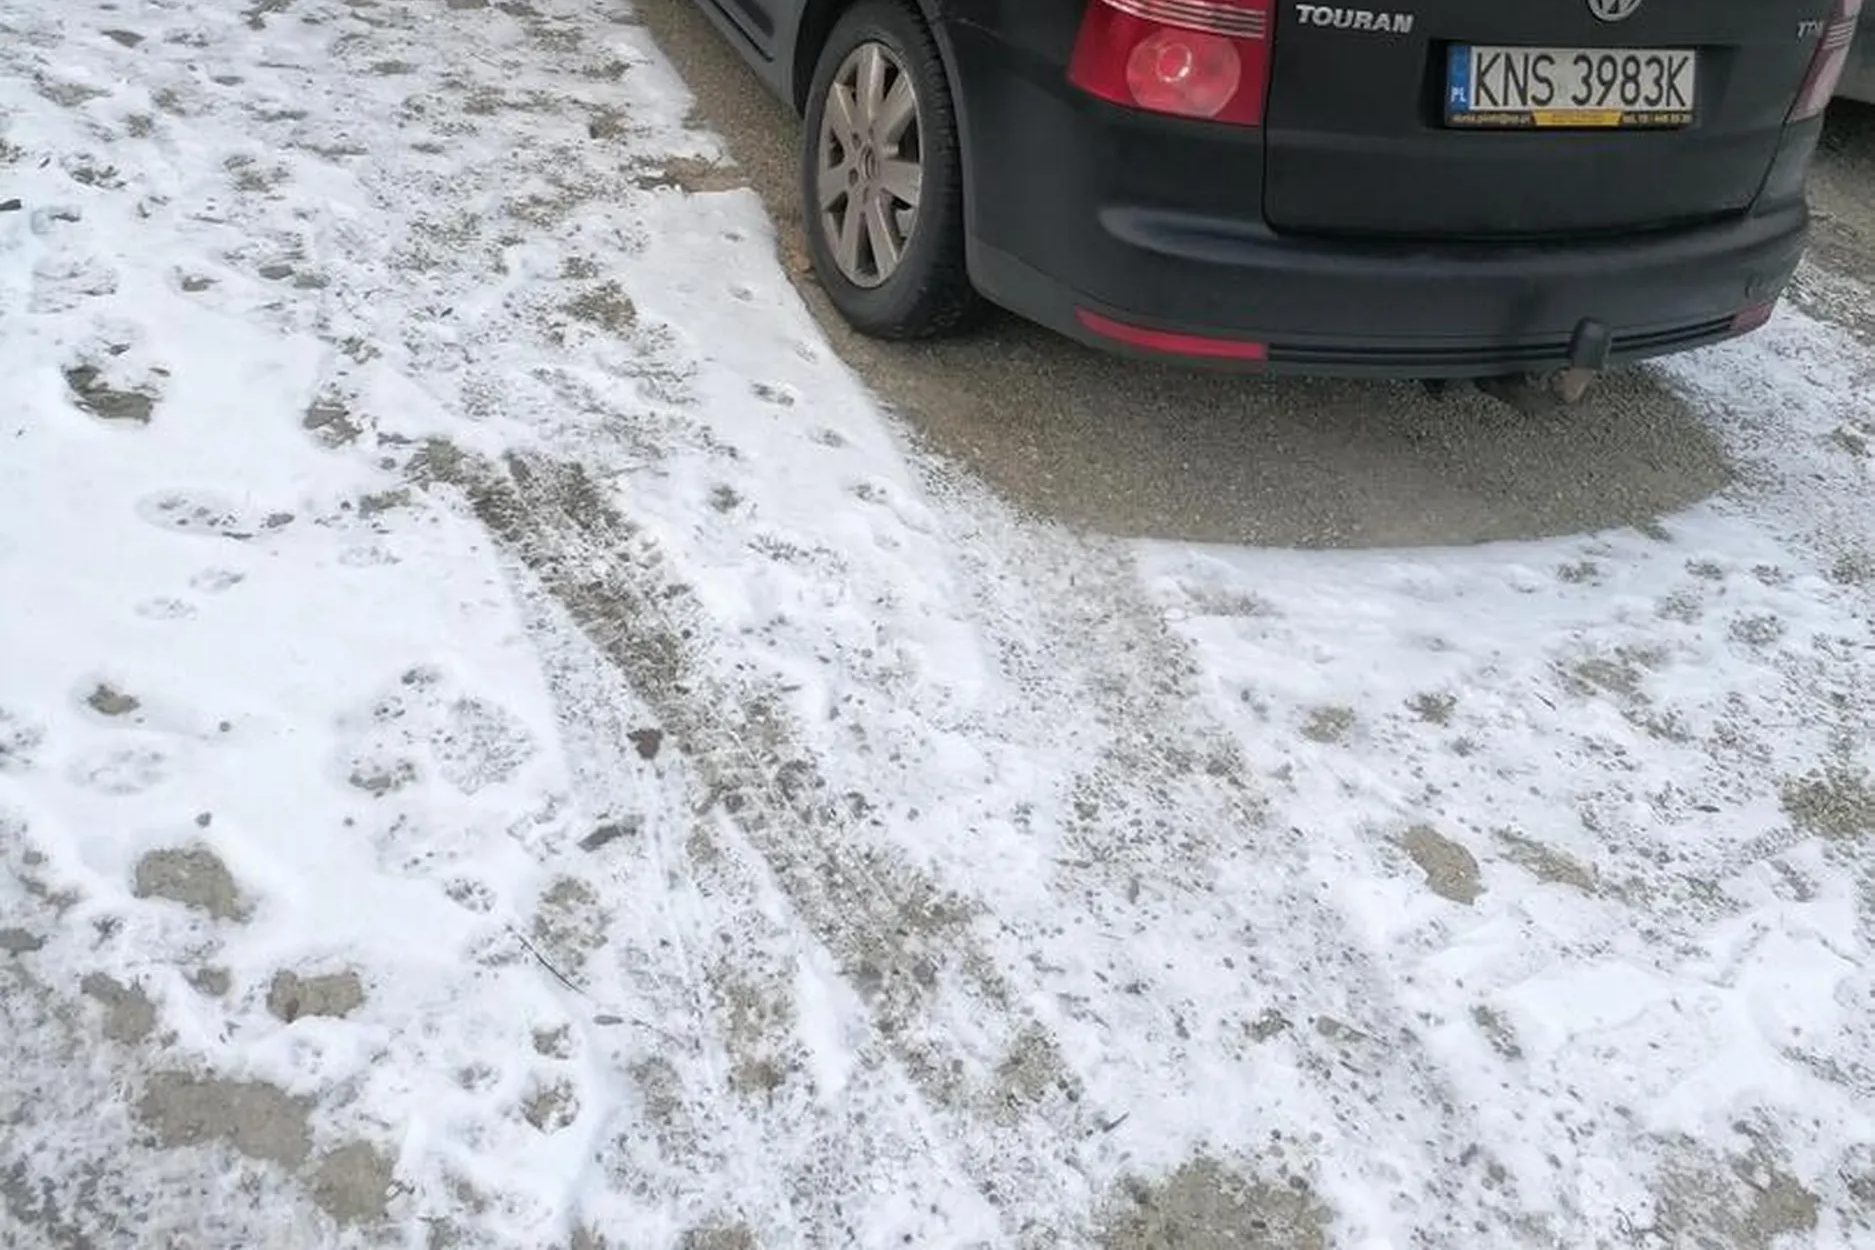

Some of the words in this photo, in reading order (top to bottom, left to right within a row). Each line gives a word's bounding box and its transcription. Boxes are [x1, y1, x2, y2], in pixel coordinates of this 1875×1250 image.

[1296, 4, 1413, 34] TOURAN
[1450, 85, 1467, 103] PL
[1475, 52, 1555, 107] KNS
[1571, 54, 1689, 107] 3983K
